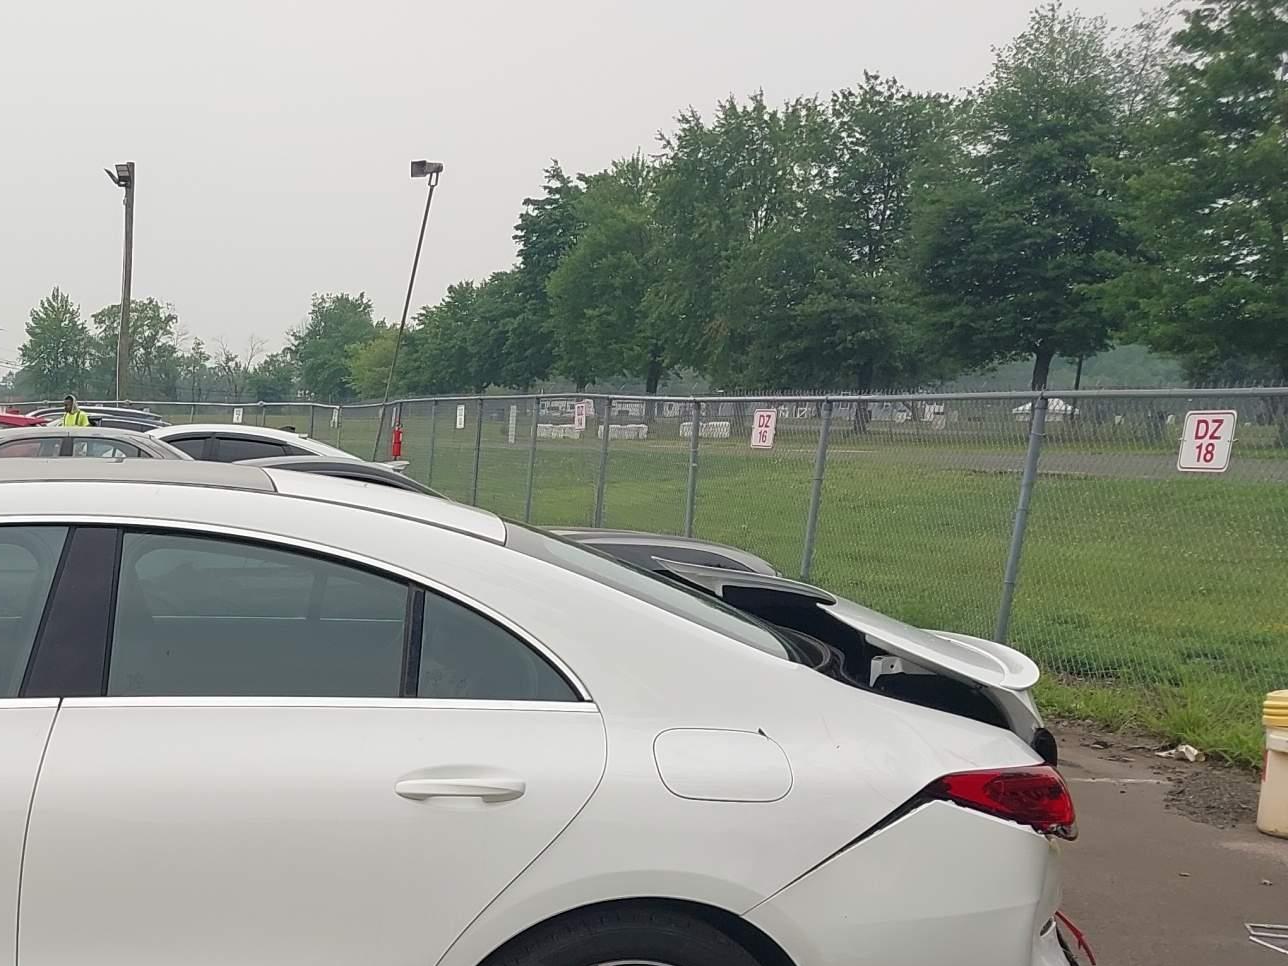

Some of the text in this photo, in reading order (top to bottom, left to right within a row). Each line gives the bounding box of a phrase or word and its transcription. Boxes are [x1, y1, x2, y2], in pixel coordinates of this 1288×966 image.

[758, 414, 772, 428] DZ
[1194, 418, 1224, 440] DZ
[758, 430, 768, 443] 16
[1195, 442, 1215, 463] 18
